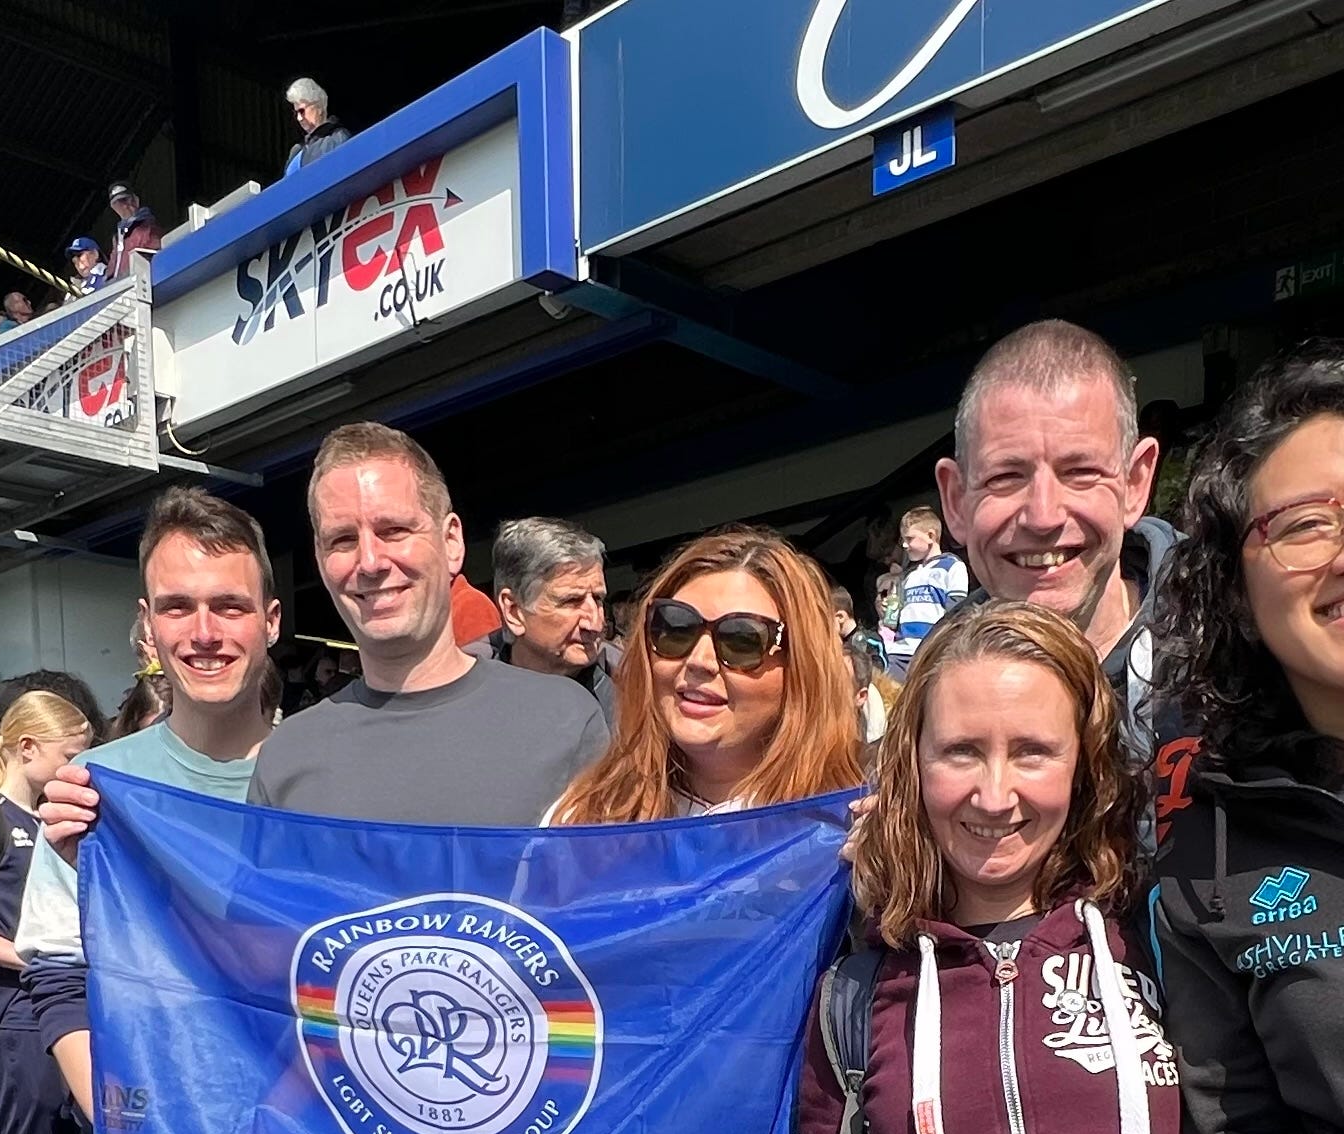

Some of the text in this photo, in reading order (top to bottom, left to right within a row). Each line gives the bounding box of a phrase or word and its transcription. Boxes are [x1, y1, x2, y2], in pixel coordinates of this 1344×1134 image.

[889, 126, 937, 176] JL
[1302, 263, 1333, 284] EXIT
[1251, 895, 1317, 925] errea
[311, 913, 559, 987] RAINBOW RANGERS
[354, 950, 527, 1044] QUEENS PARK RANGERS
[332, 1075, 375, 1123] LGBT
[417, 1103, 467, 1123] 1882
